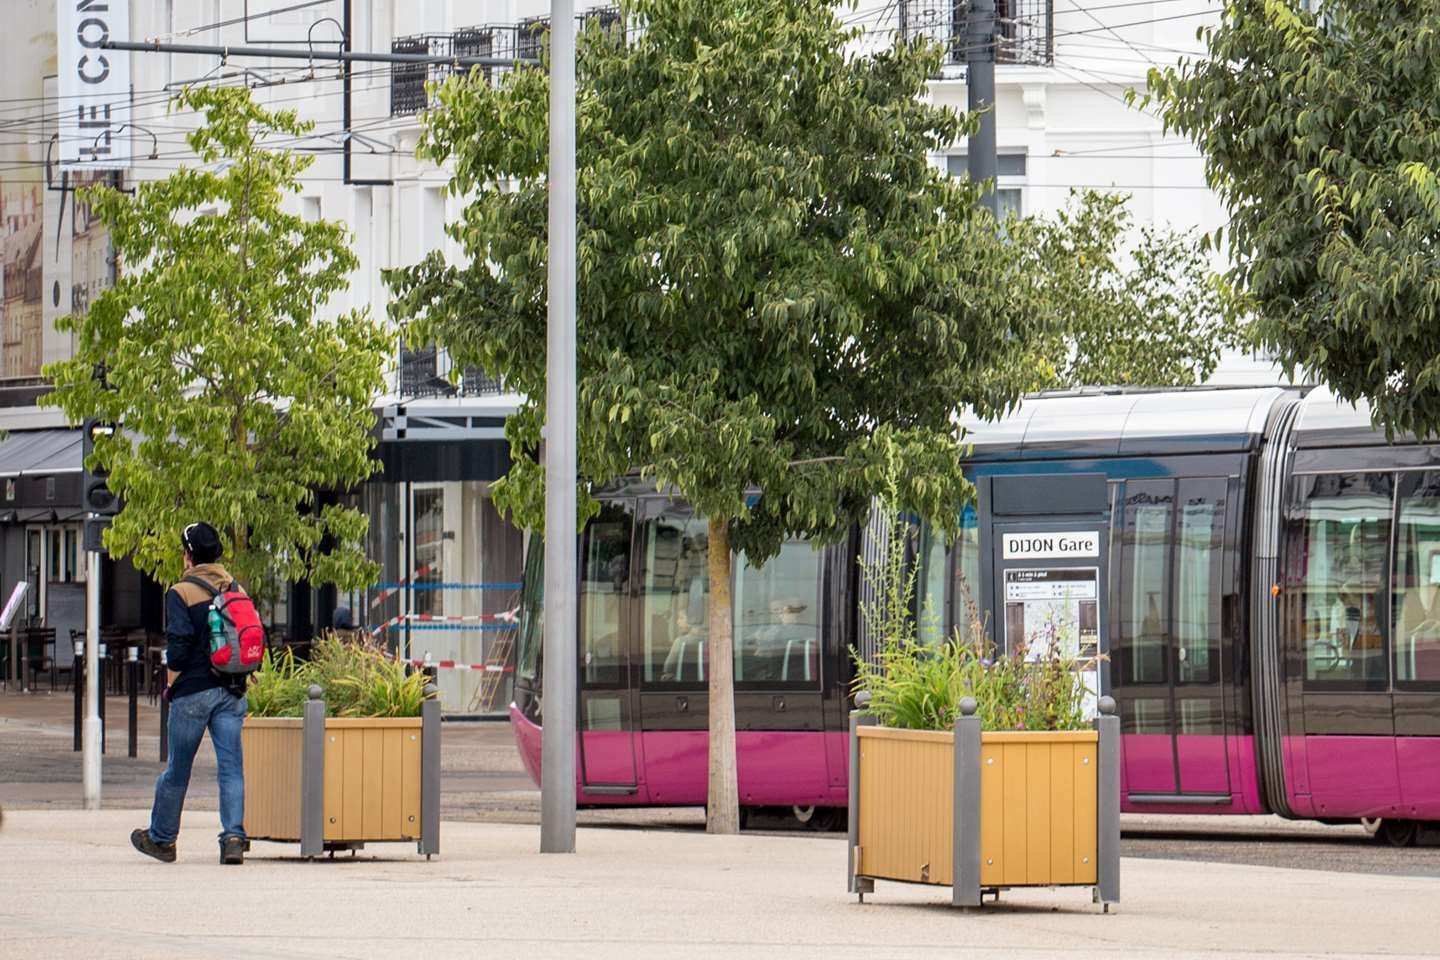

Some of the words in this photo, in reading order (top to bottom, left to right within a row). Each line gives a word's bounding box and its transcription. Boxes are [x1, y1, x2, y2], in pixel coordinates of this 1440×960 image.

[78, 104, 112, 156] LE
[1009, 539, 1054, 553] DIJON
[1058, 537, 1093, 552] Gare
